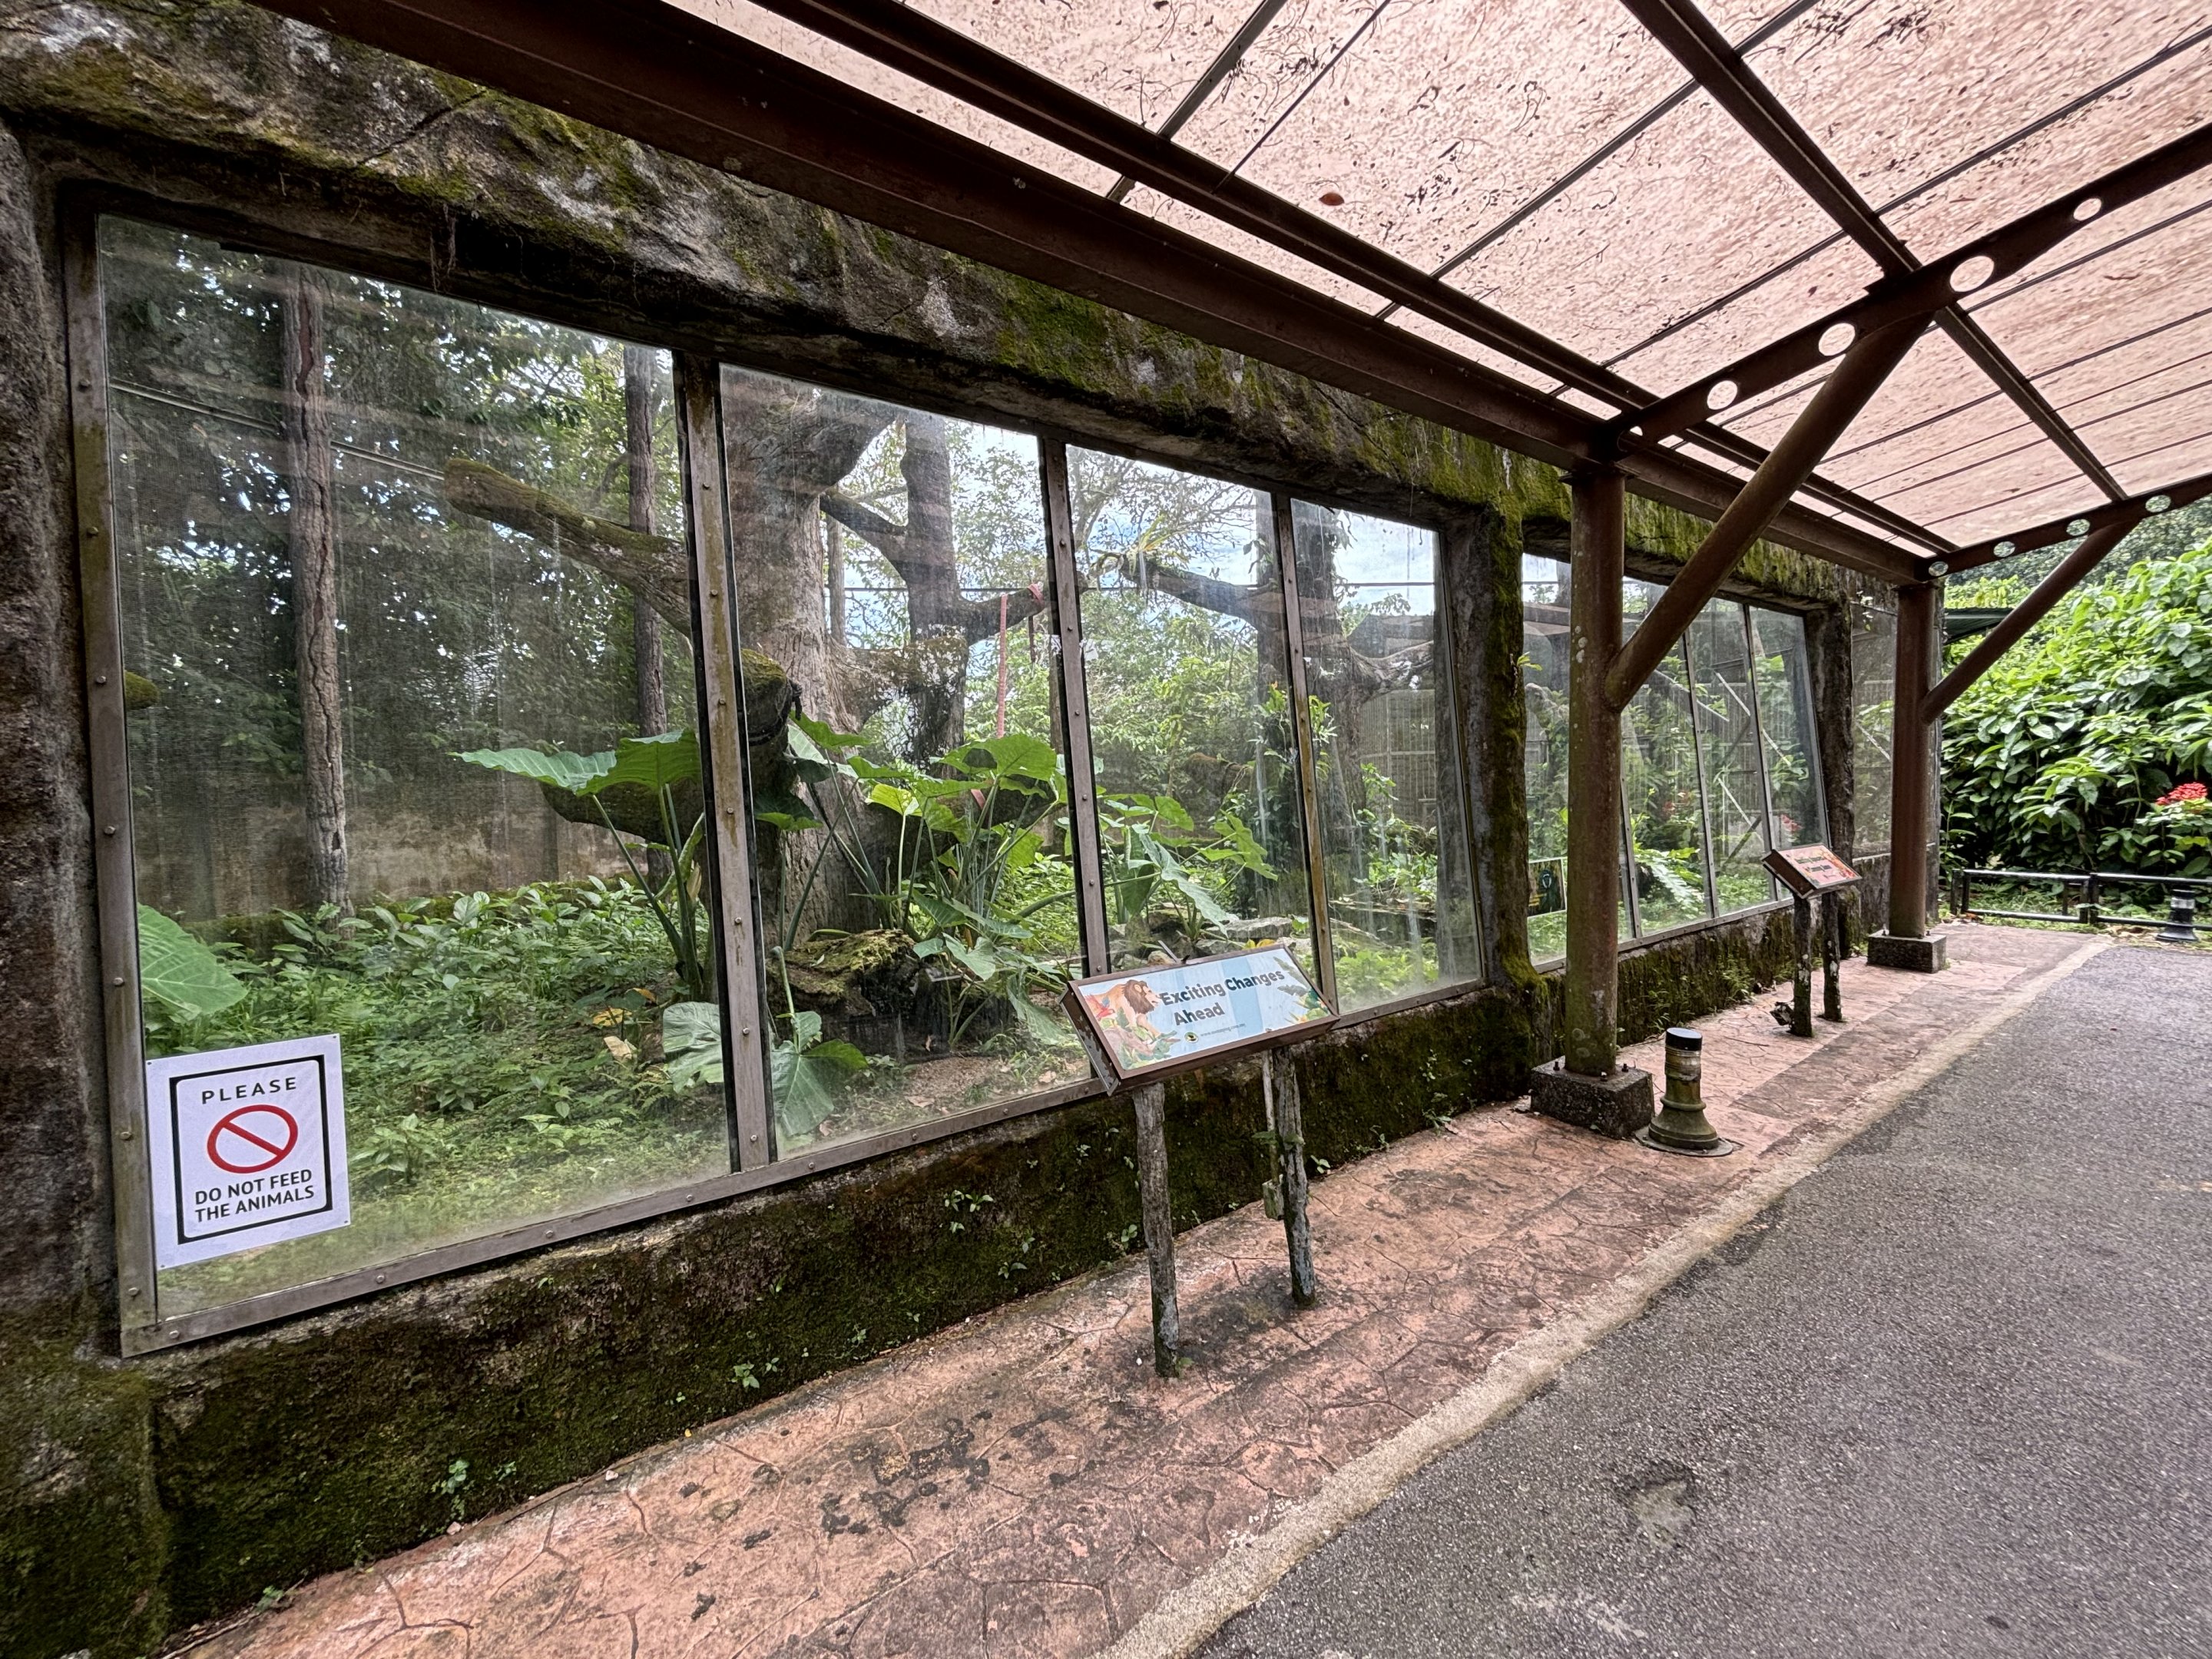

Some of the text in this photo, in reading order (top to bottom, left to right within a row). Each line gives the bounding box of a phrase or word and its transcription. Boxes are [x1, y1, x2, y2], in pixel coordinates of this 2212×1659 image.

[1160, 970, 1285, 1006] Exciting Changes
[1174, 1002, 1225, 1026] Ahead
[201, 1076, 297, 1104] PLEASE
[194, 1168, 313, 1205] DO NOT FEED
[194, 1184, 315, 1223] THE ANIMALS
